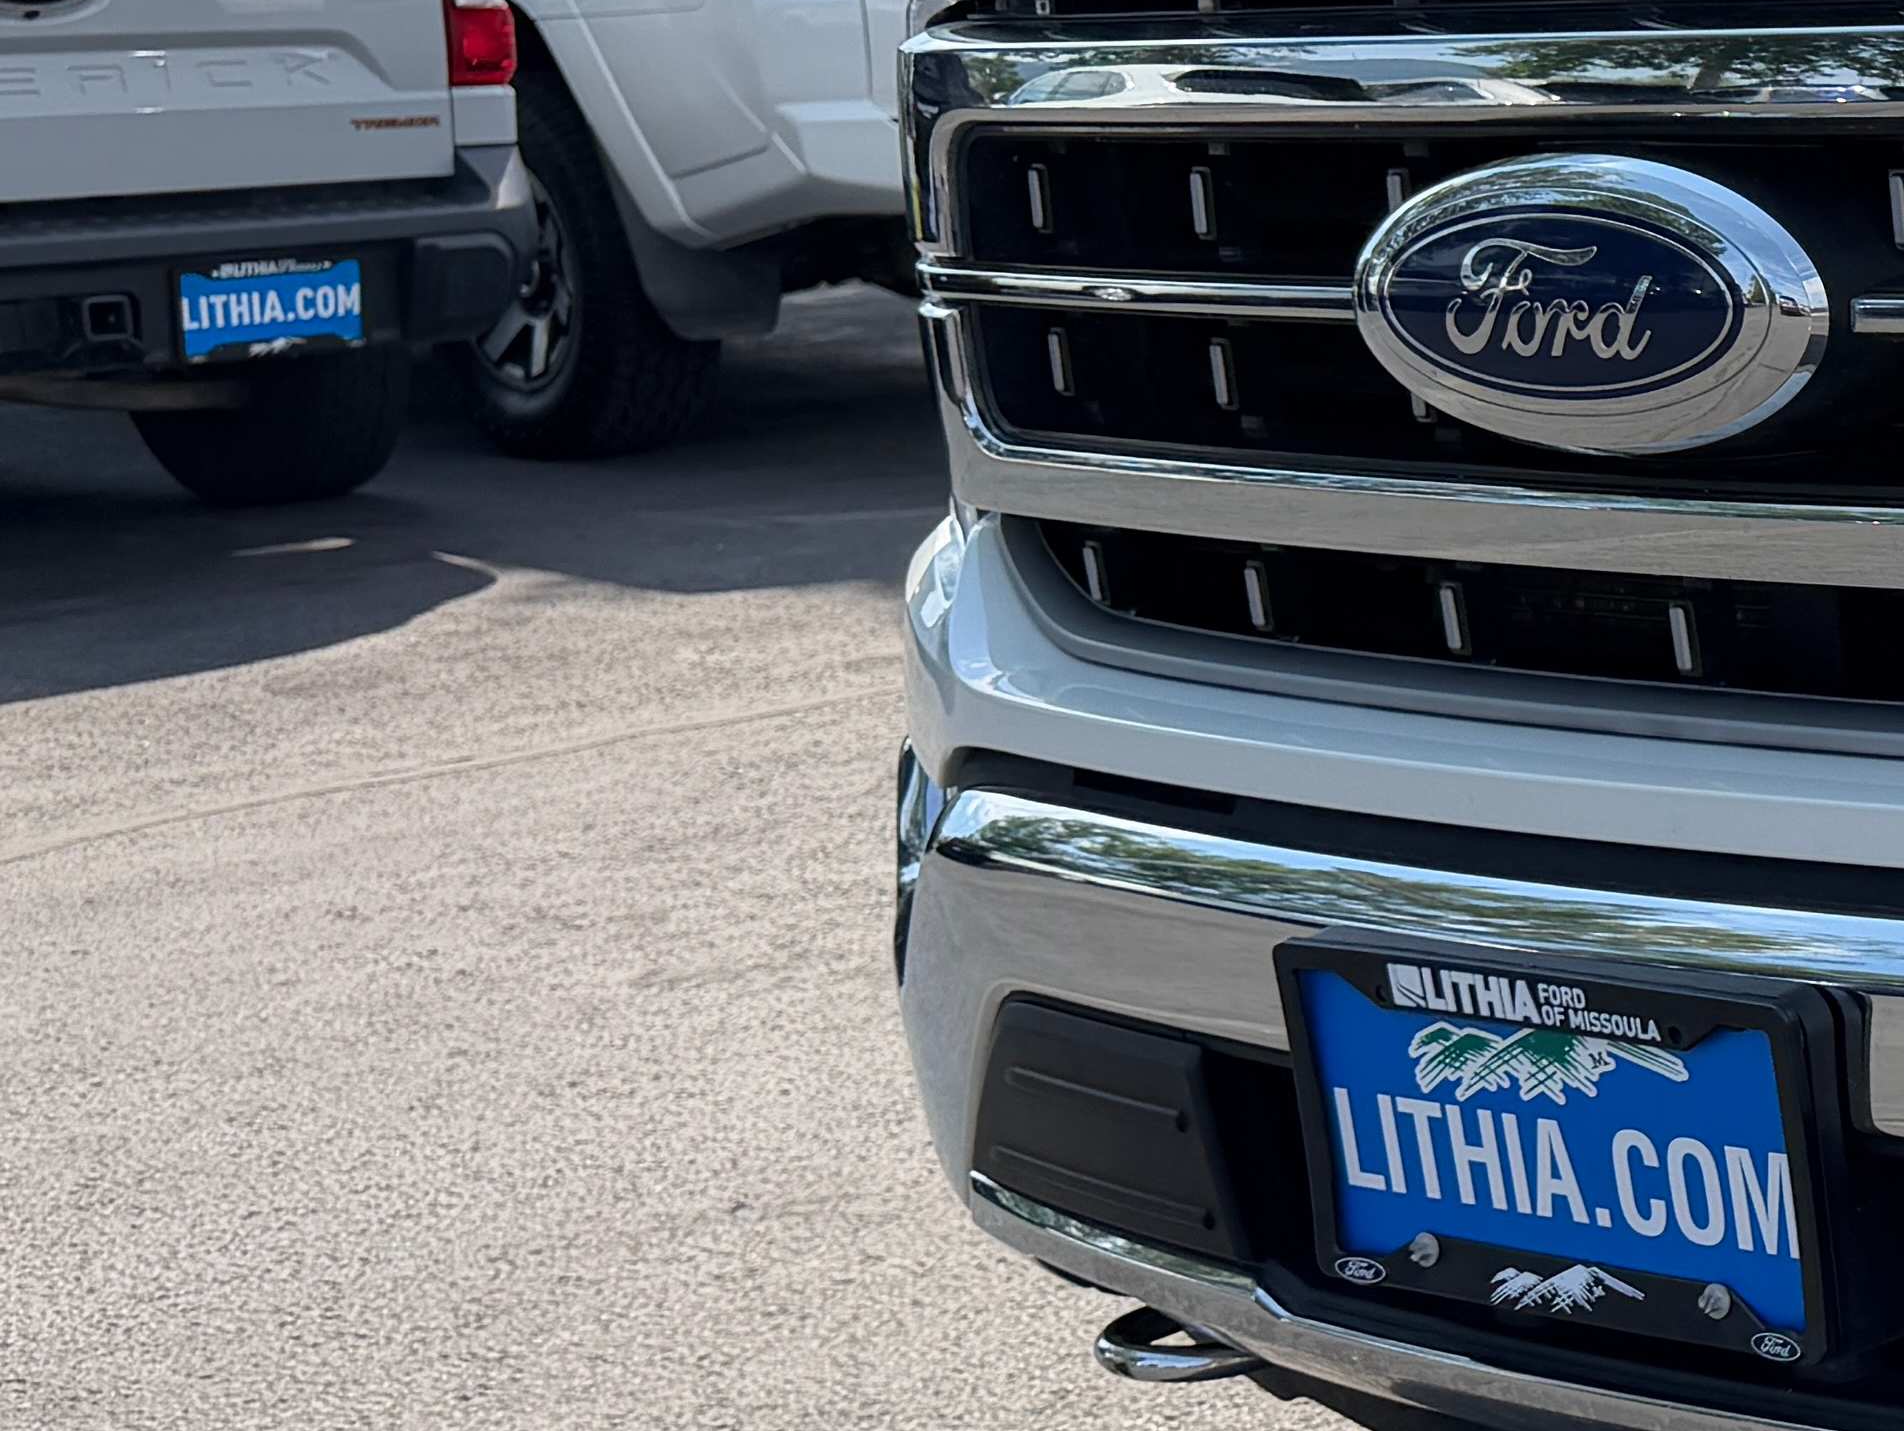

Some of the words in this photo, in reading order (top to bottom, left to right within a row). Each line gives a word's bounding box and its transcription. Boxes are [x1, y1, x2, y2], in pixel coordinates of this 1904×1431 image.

[181, 282, 361, 332] LITHIA.COM
[1446, 237, 1652, 361] Ford
[1421, 967, 1542, 1024] LITHIA
[1537, 983, 1586, 1009] FORD
[1541, 1005, 1566, 1027] OF
[1568, 1011, 1662, 1042] MISSOULA
[1333, 1086, 1800, 1260] LITHIA.COM
[1344, 1260, 1377, 1280] Ford
[1760, 1335, 1791, 1357] Ford
